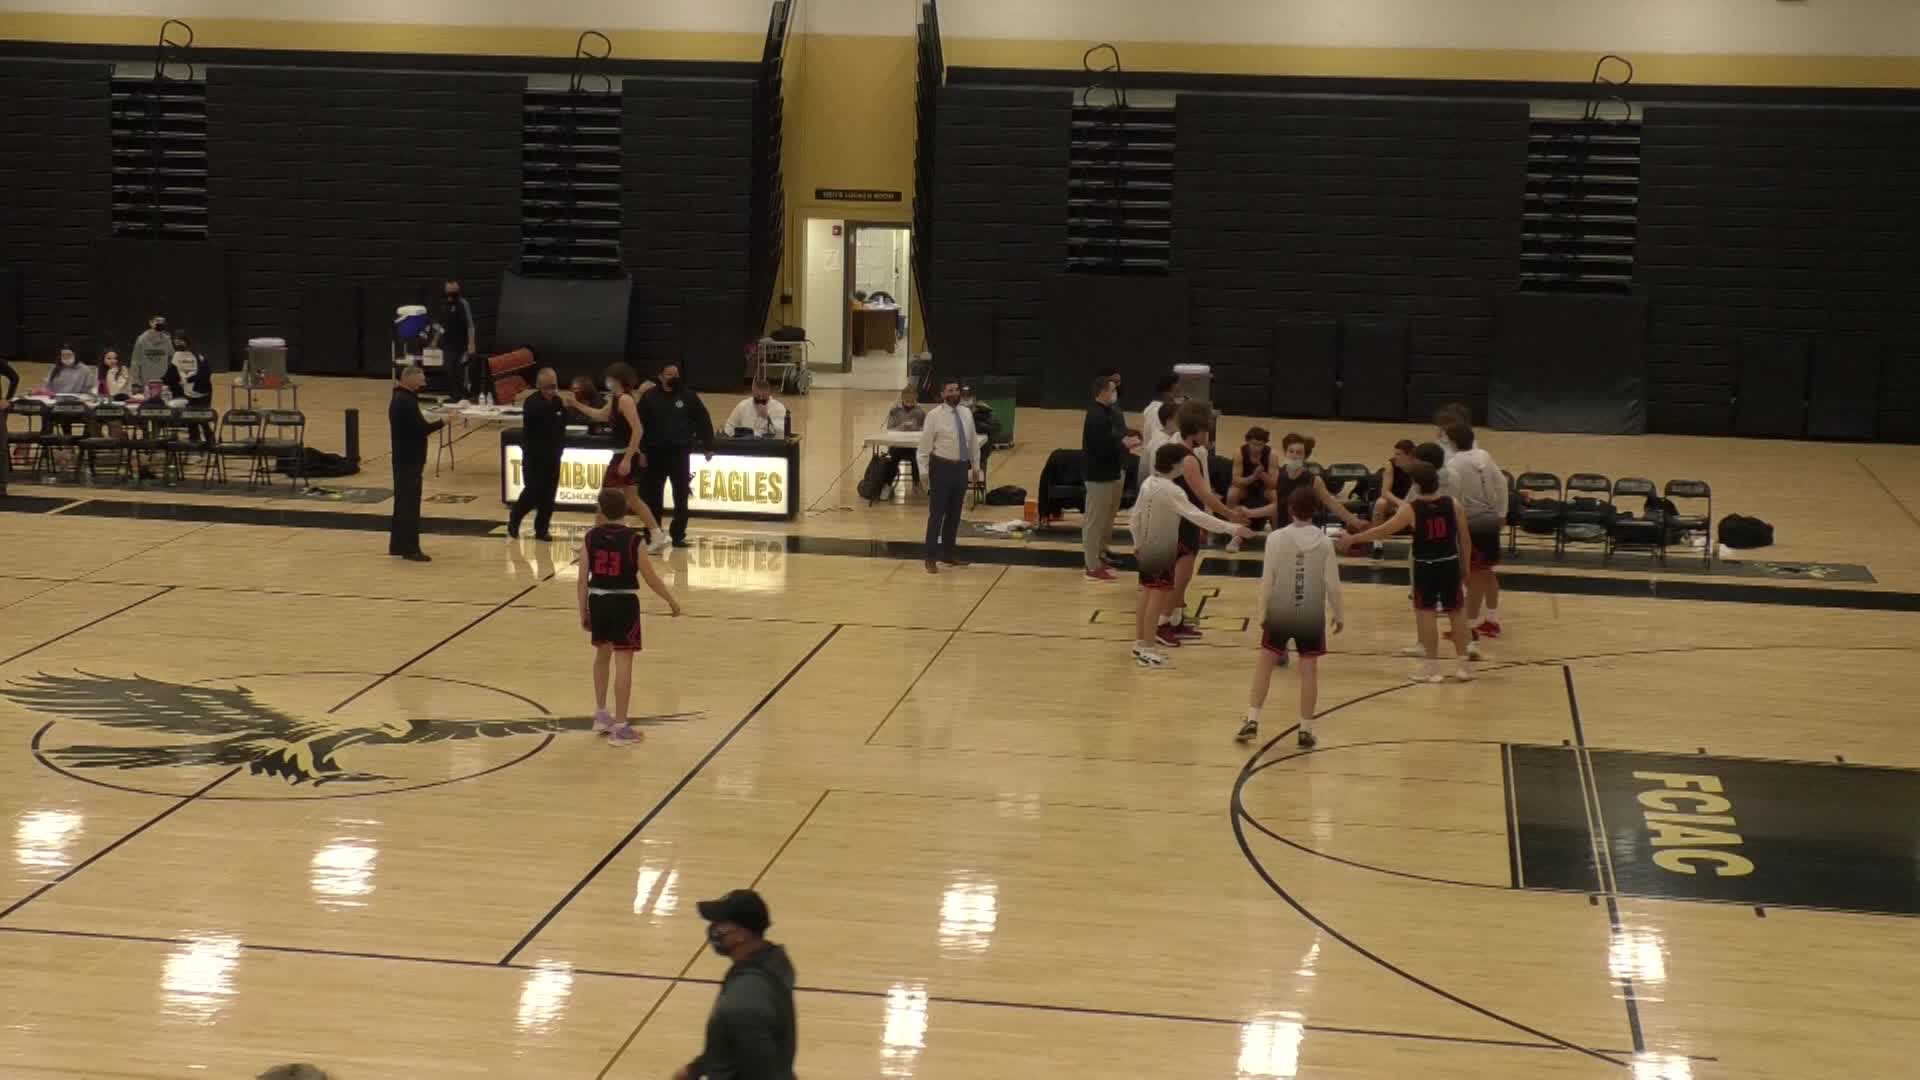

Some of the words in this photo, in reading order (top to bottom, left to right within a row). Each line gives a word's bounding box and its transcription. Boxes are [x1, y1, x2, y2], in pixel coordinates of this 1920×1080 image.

[510, 458, 608, 489] TMBU
[699, 468, 783, 505] EAGLES
[1424, 517, 1448, 540] 10
[593, 549, 622, 577] 23
[1632, 771, 1755, 877] FCIAC
